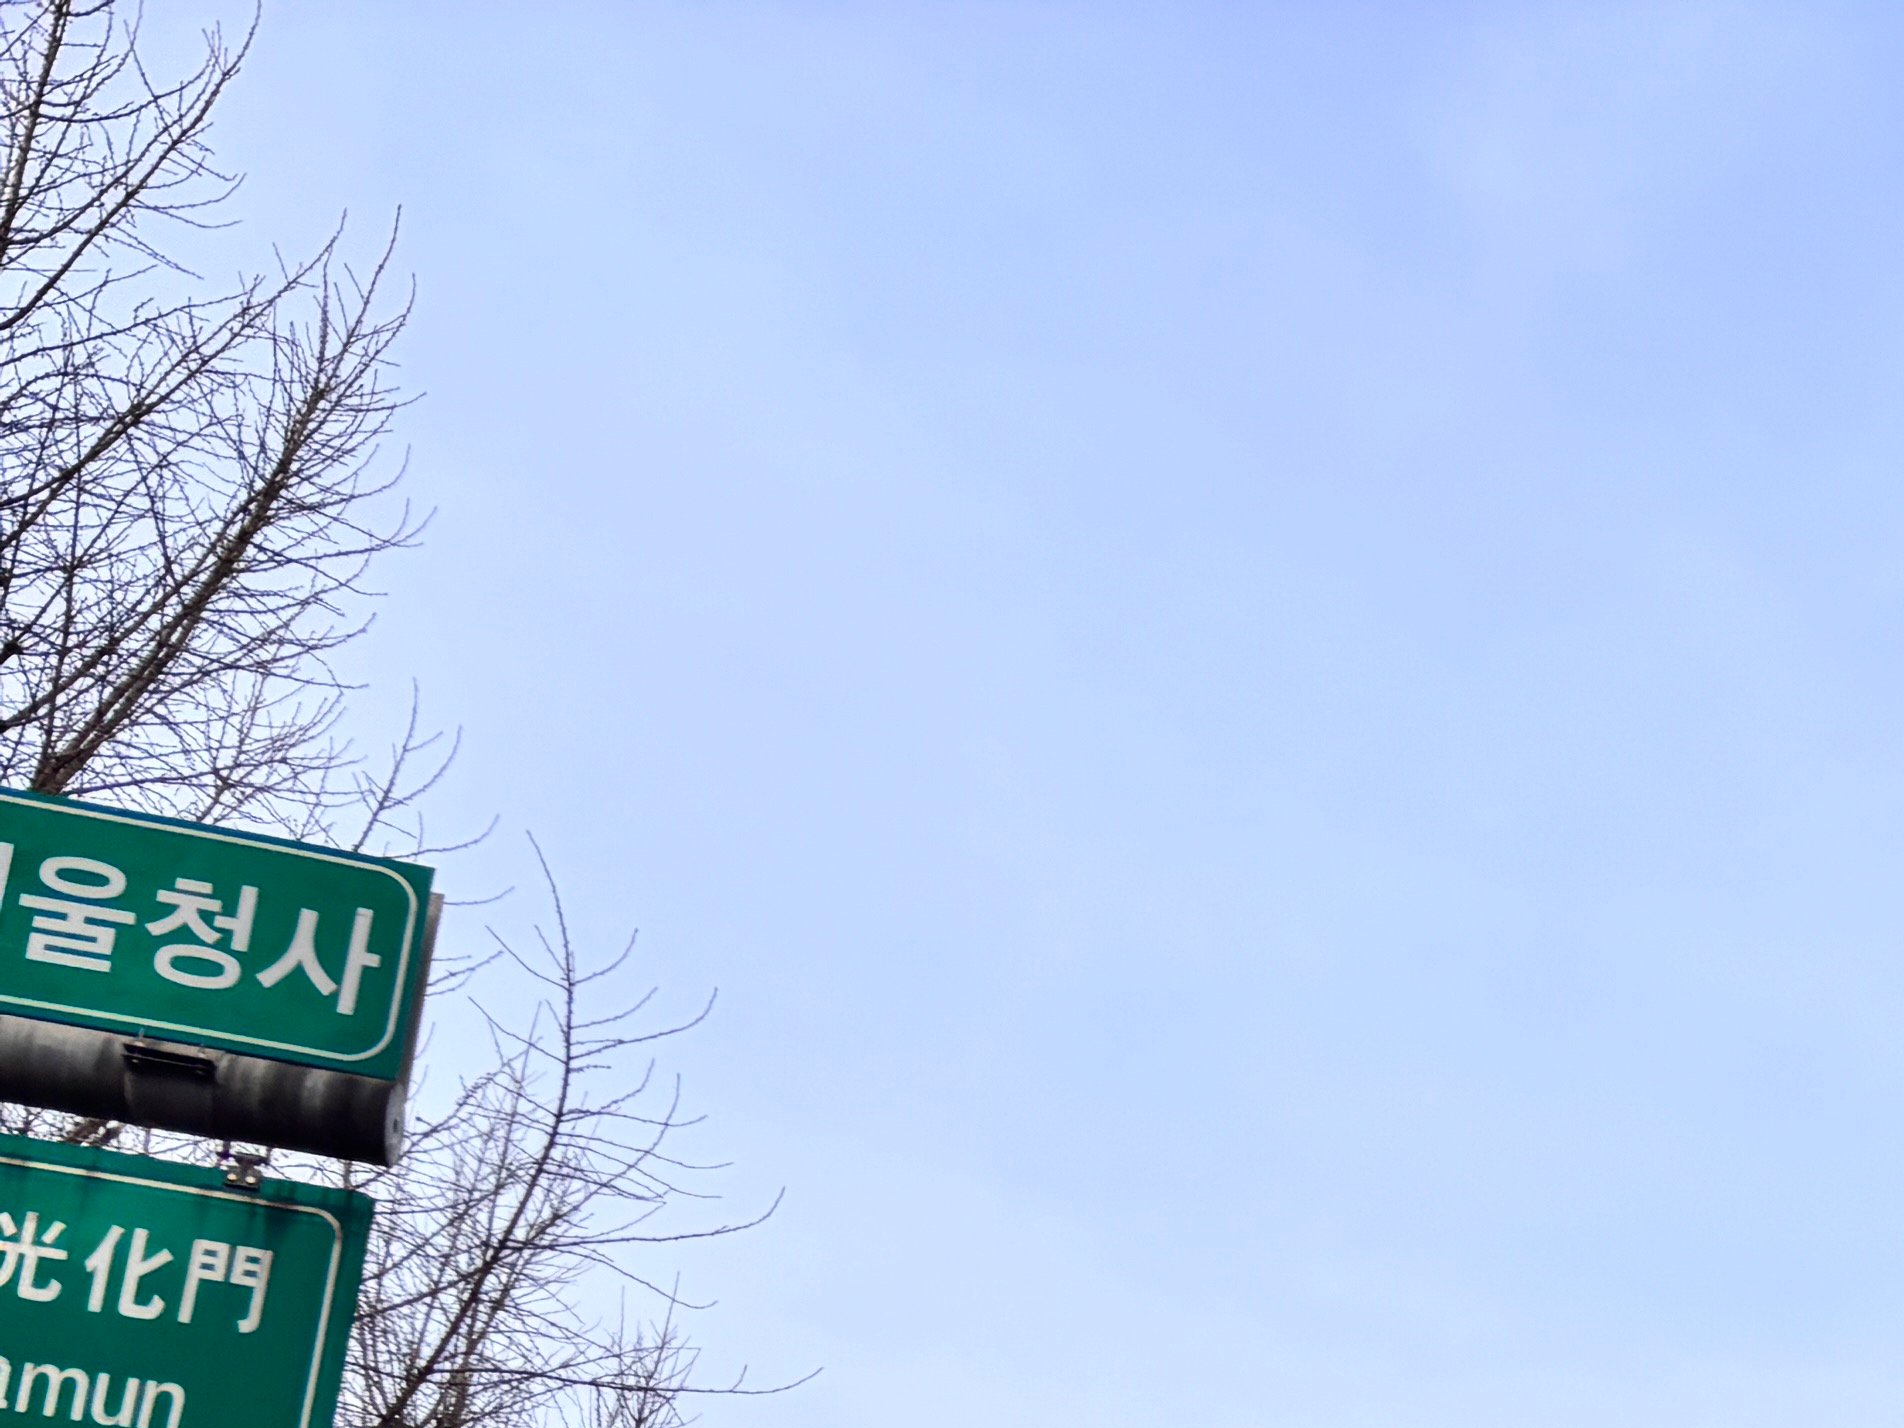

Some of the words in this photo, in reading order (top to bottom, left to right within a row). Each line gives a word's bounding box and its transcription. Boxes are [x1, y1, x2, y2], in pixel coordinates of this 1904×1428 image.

[0, 842, 381, 1015] 울청사
[0, 1211, 273, 1334] 光化門
